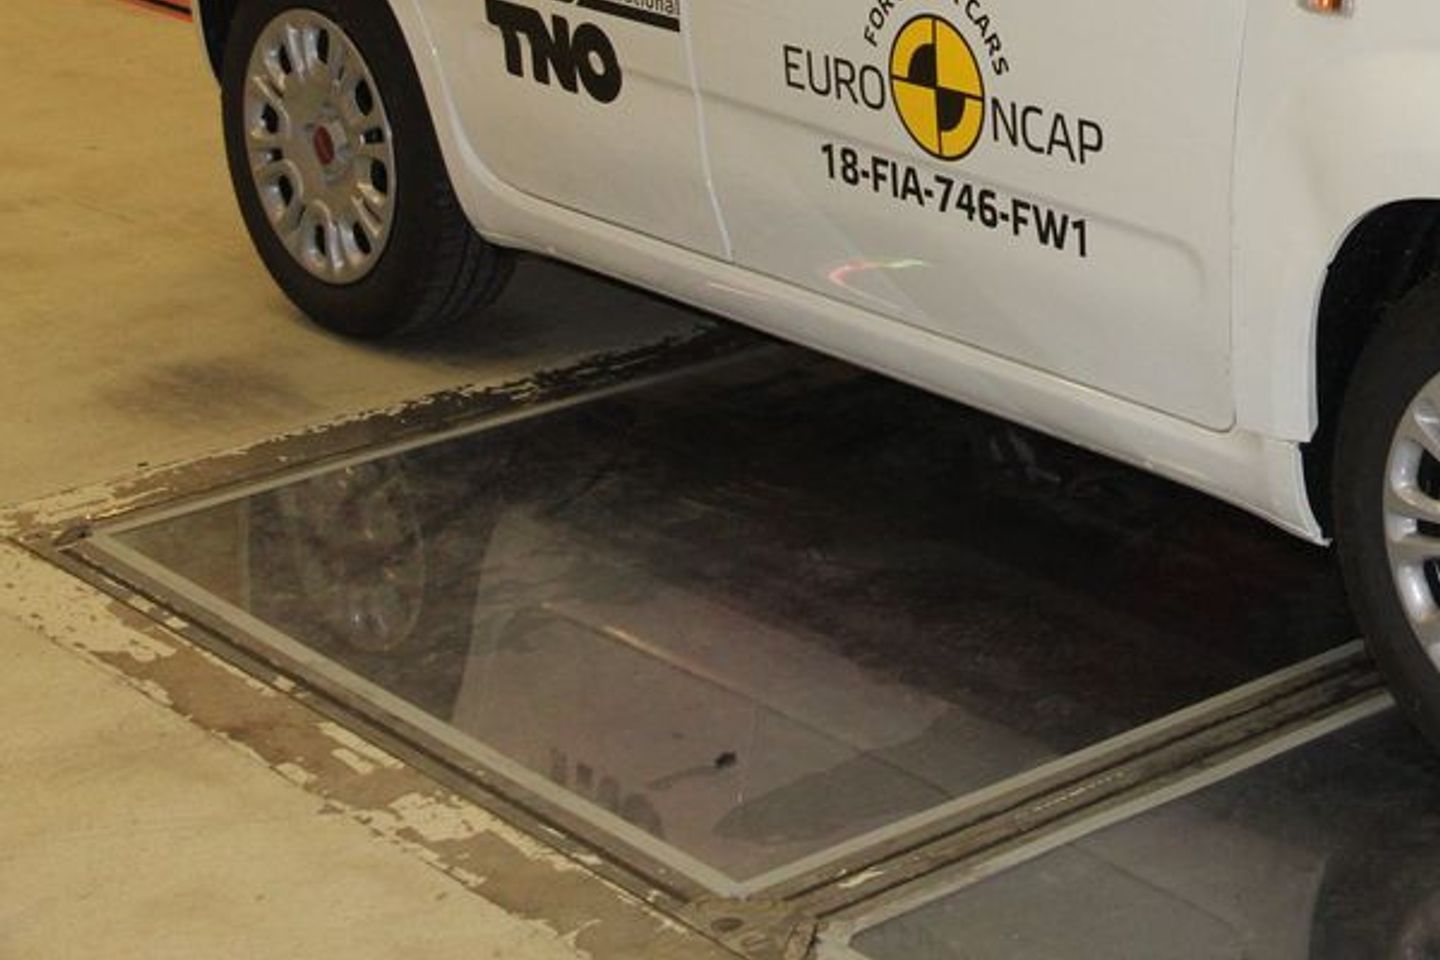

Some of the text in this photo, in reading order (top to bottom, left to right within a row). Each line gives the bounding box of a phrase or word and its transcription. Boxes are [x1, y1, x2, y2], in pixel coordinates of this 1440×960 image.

[782, 44, 1104, 165] EURO NCAP
[820, 142, 1088, 259] 18-FIA-746-FW1
